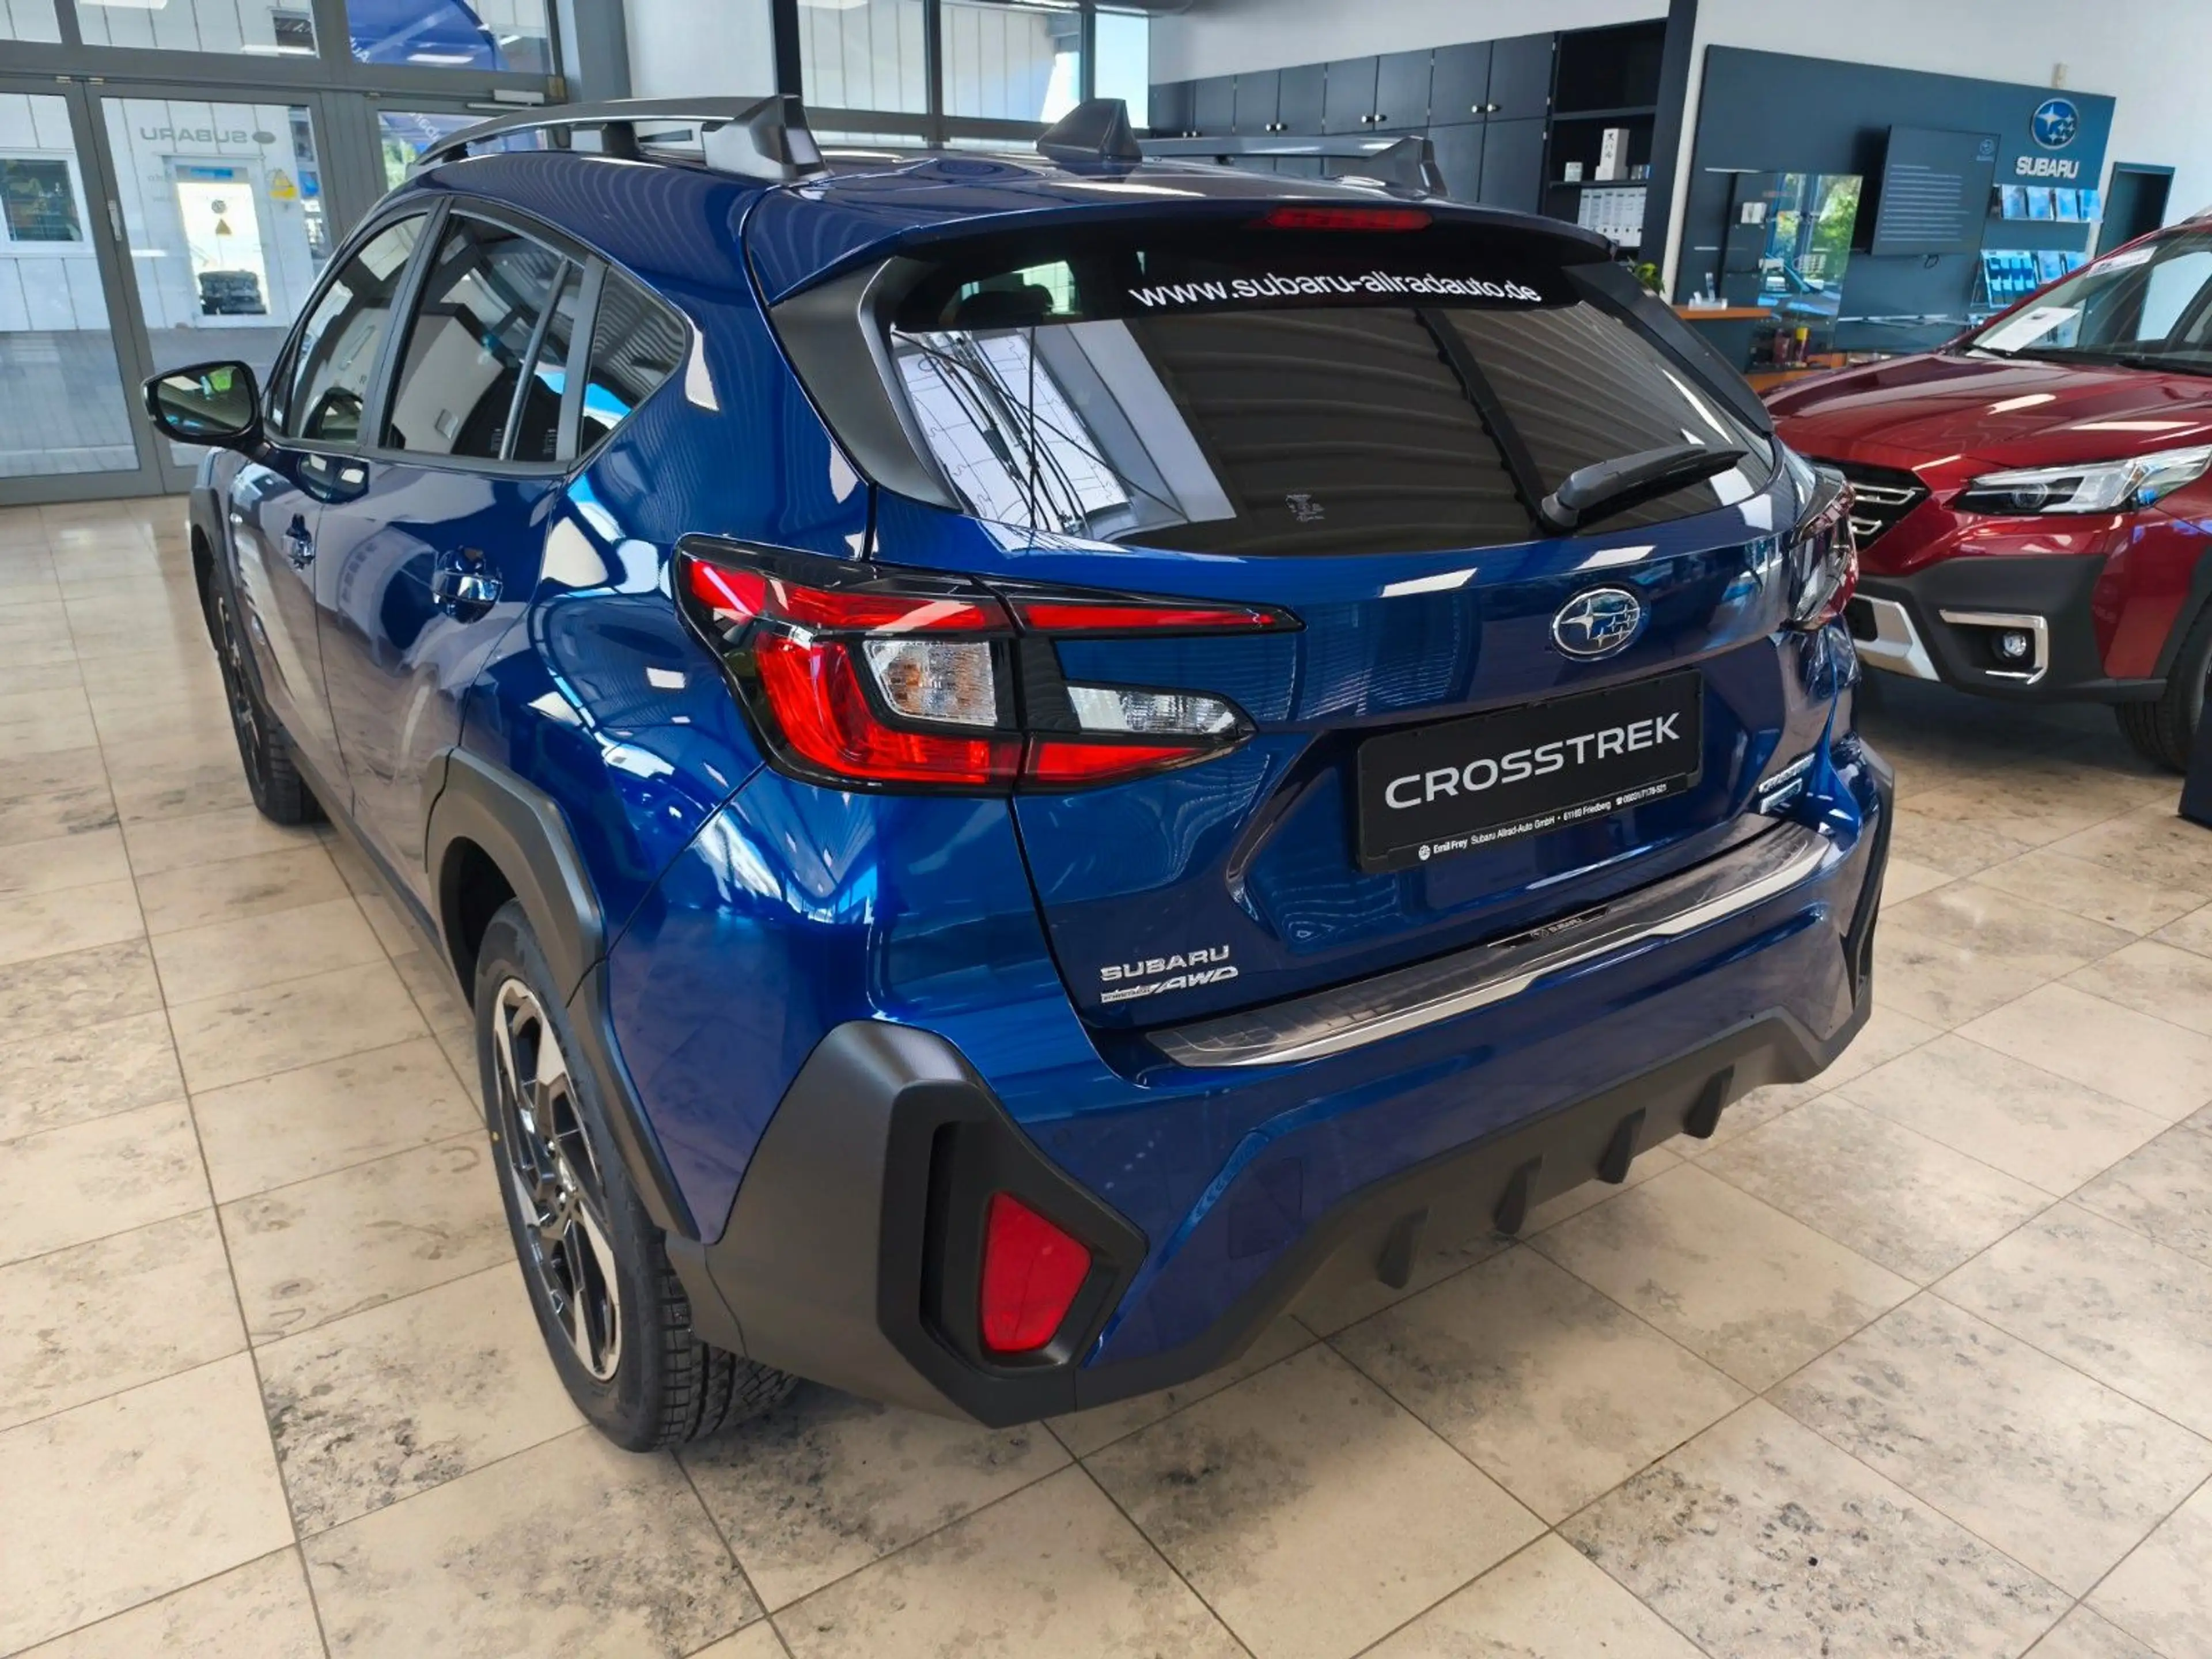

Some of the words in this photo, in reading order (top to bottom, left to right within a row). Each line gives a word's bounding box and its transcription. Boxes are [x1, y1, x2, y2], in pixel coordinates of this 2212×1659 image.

[2016, 156, 2079, 179] SUBARU
[1130, 270, 1542, 308] www.subaru-allradauto.de
[1385, 712, 1680, 809] CROSSTREK
[1433, 842, 1450, 854] Emil
[1450, 838, 1468, 850] Frey
[1471, 834, 1496, 845] Subaru
[1497, 823, 1533, 839] Allrad-Auto
[1534, 816, 1555, 828] GmbH
[1583, 801, 1612, 816] Friedberg
[1100, 945, 1230, 982] SUBARU
[1153, 965, 1238, 994] AWD
